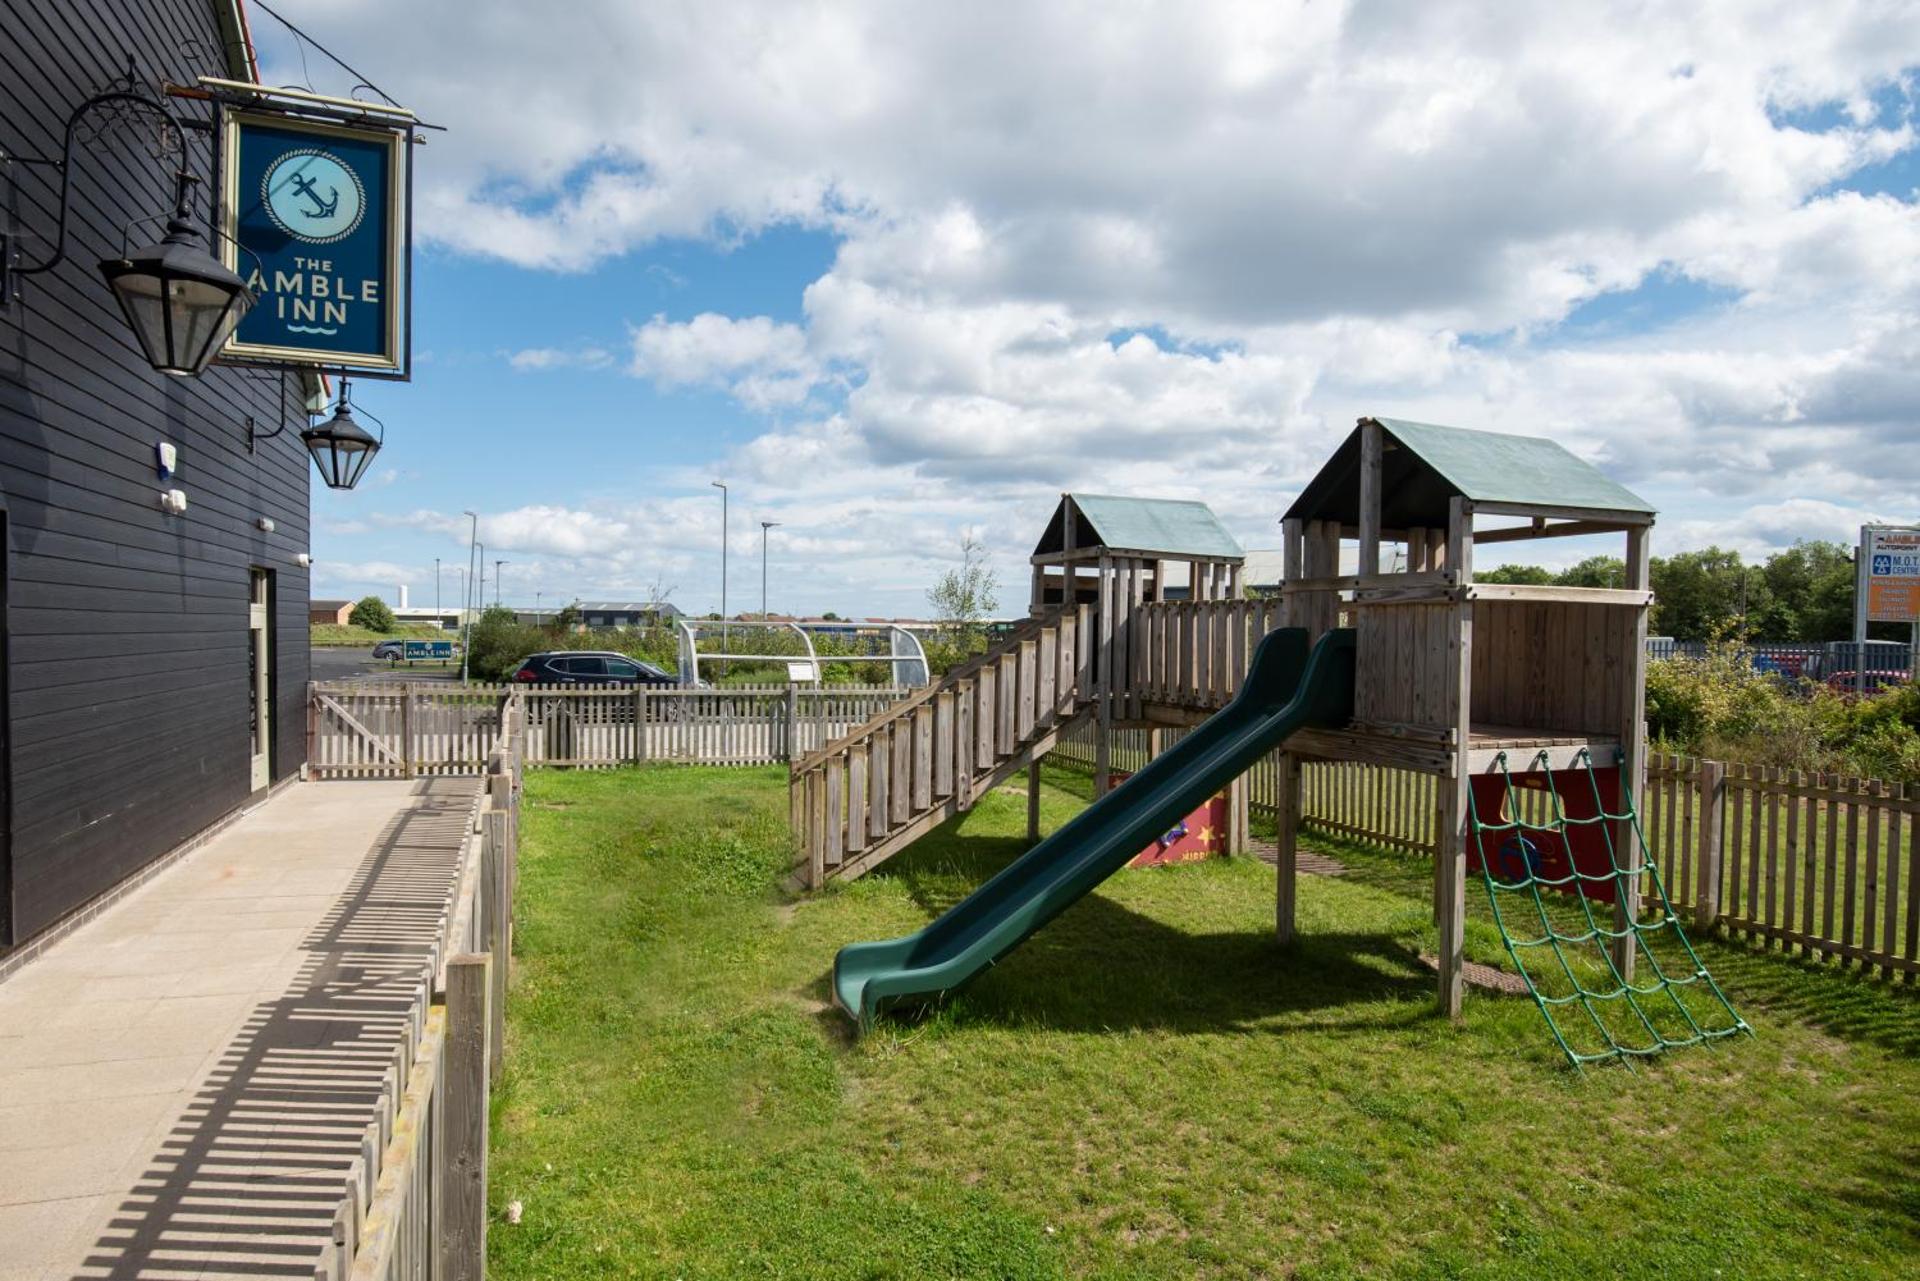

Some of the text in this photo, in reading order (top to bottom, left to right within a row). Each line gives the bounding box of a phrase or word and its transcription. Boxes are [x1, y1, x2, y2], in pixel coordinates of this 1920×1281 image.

[294, 257, 332, 272] THE
[247, 268, 379, 303] AMBLE
[279, 296, 346, 324] INN
